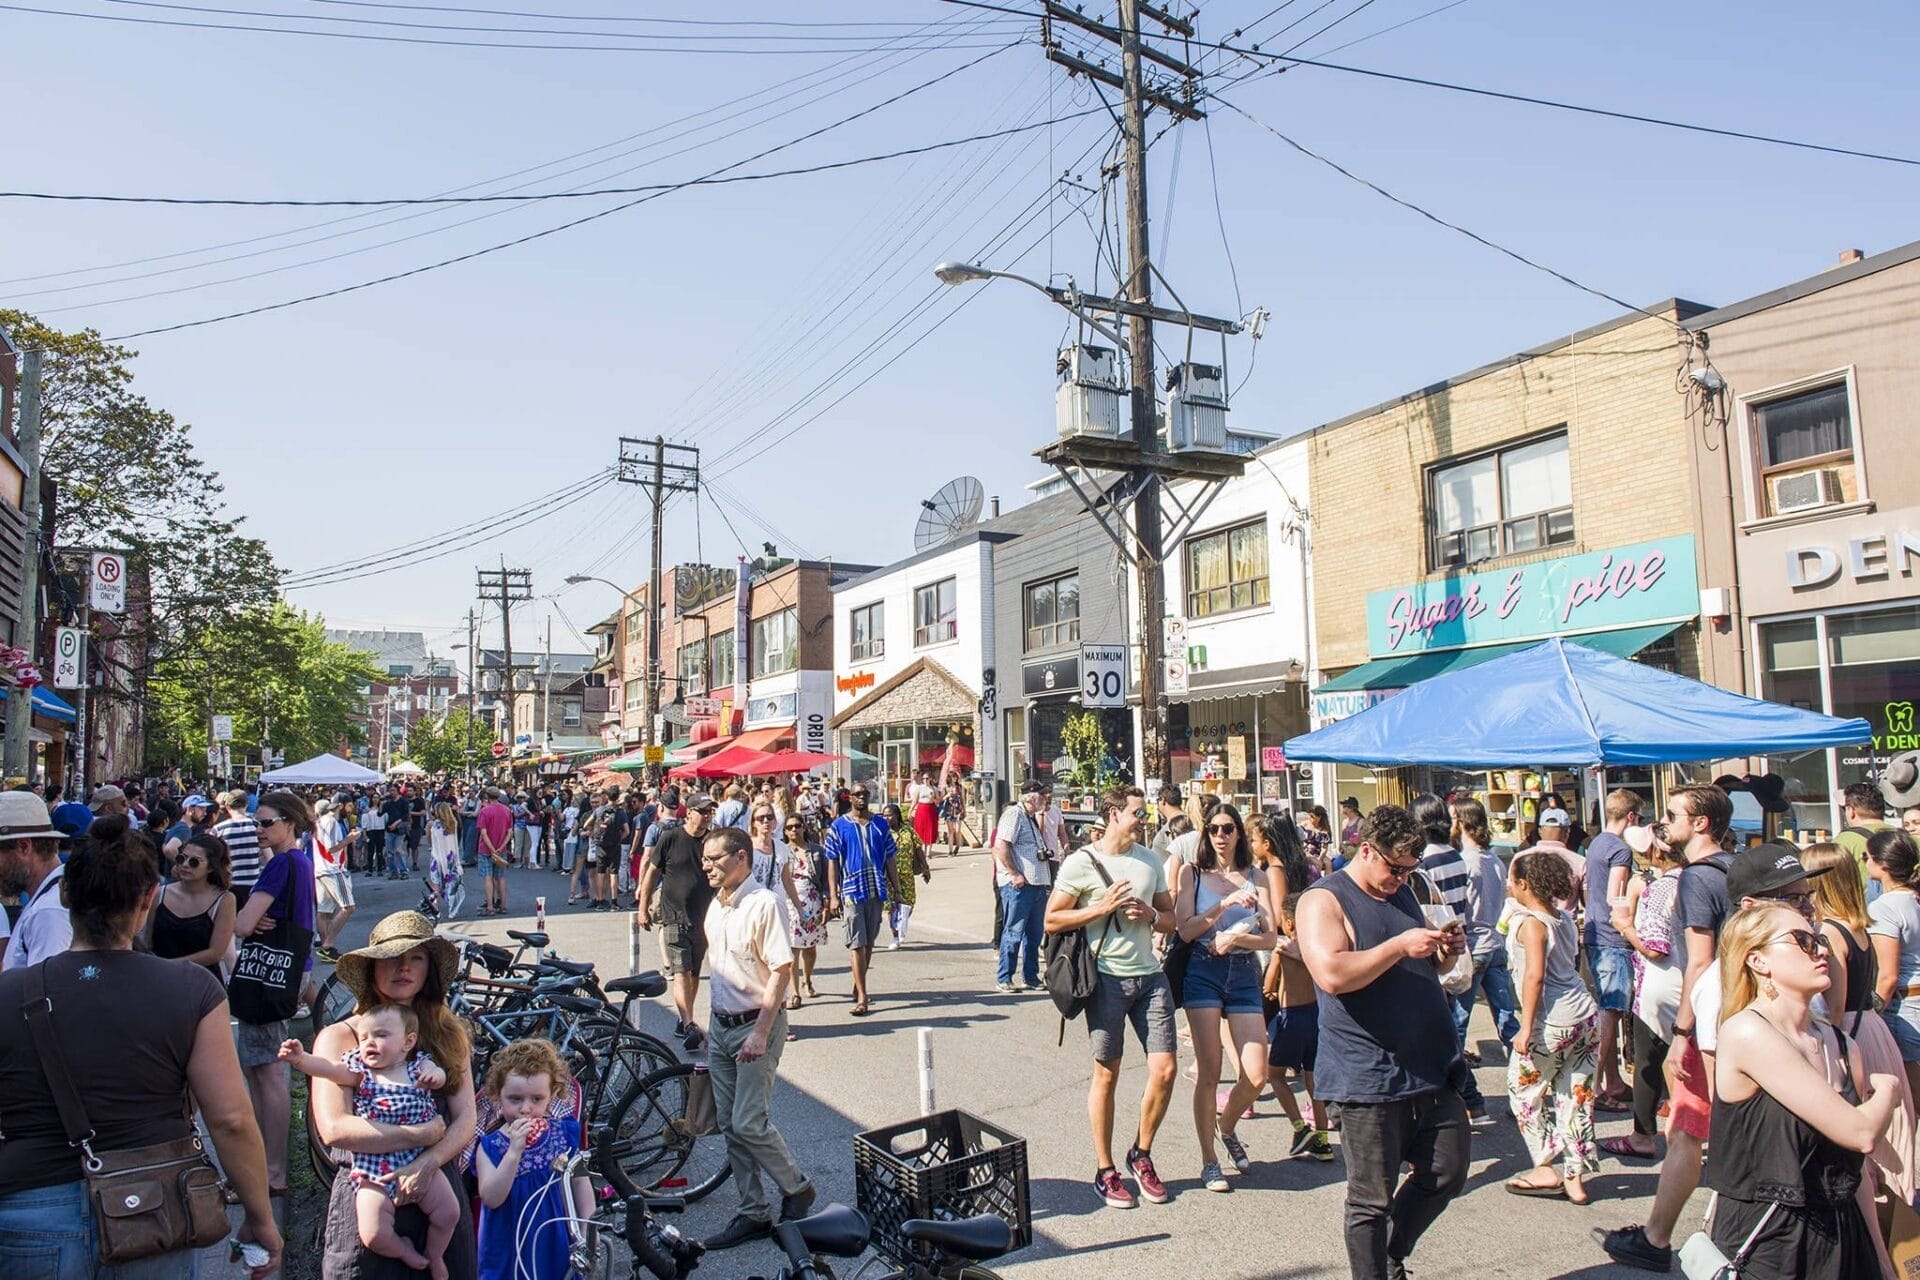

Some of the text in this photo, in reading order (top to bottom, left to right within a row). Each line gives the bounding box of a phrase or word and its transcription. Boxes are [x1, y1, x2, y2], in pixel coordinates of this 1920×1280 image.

[96, 583, 120, 593] LOADING
[101, 592, 115, 600] ONLY
[1385, 589, 1486, 650] Sugar
[1085, 652, 1122, 662] MAXIMUM
[1086, 671, 1121, 698] 30
[1887, 734, 1920, 750] DEN
[269, 969, 287, 984] CO.
